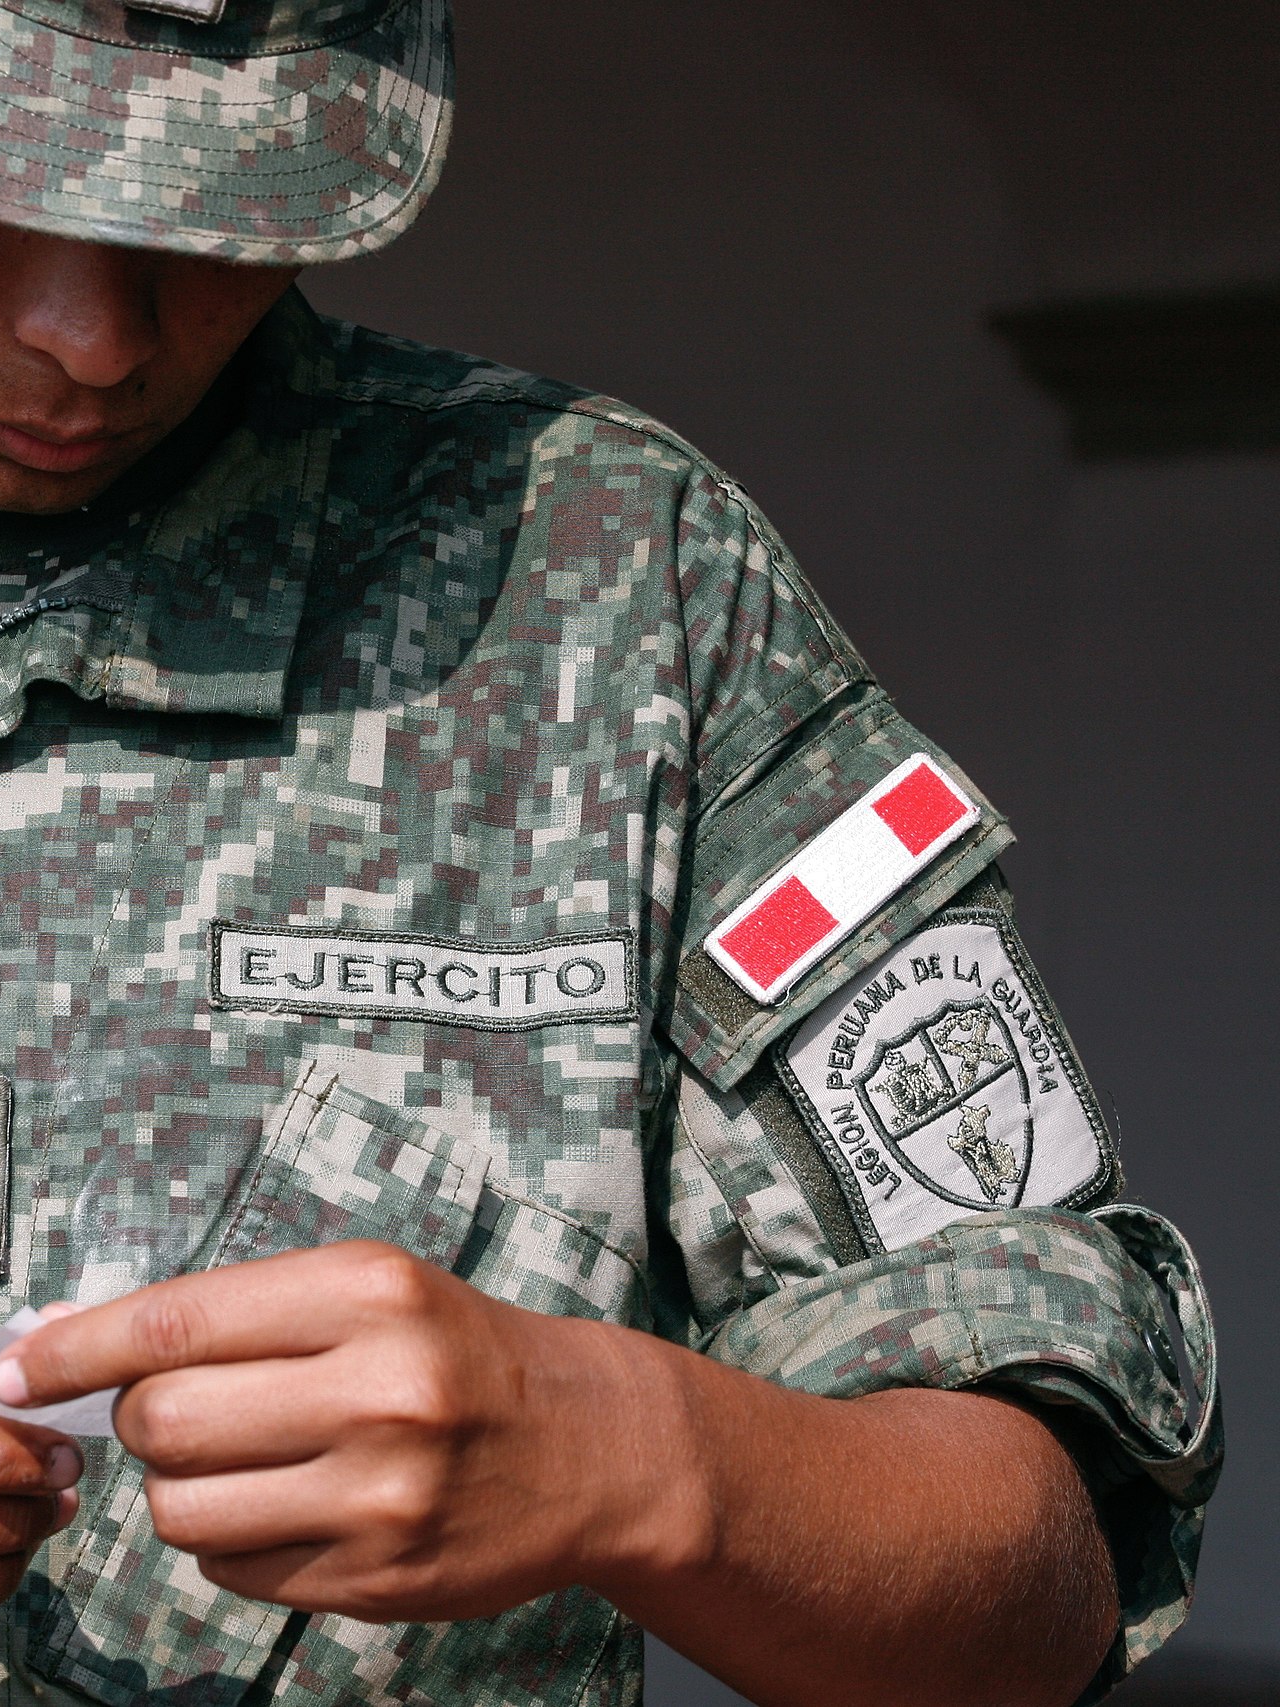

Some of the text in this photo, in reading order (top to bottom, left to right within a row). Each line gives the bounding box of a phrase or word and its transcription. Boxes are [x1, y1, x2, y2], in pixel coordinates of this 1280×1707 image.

[239, 946, 607, 1008] EJERCITO
[826, 970, 907, 1090] PERUANA
[909, 952, 944, 985] DE
[953, 954, 982, 988] LA
[991, 977, 1059, 1094] GUARDIA
